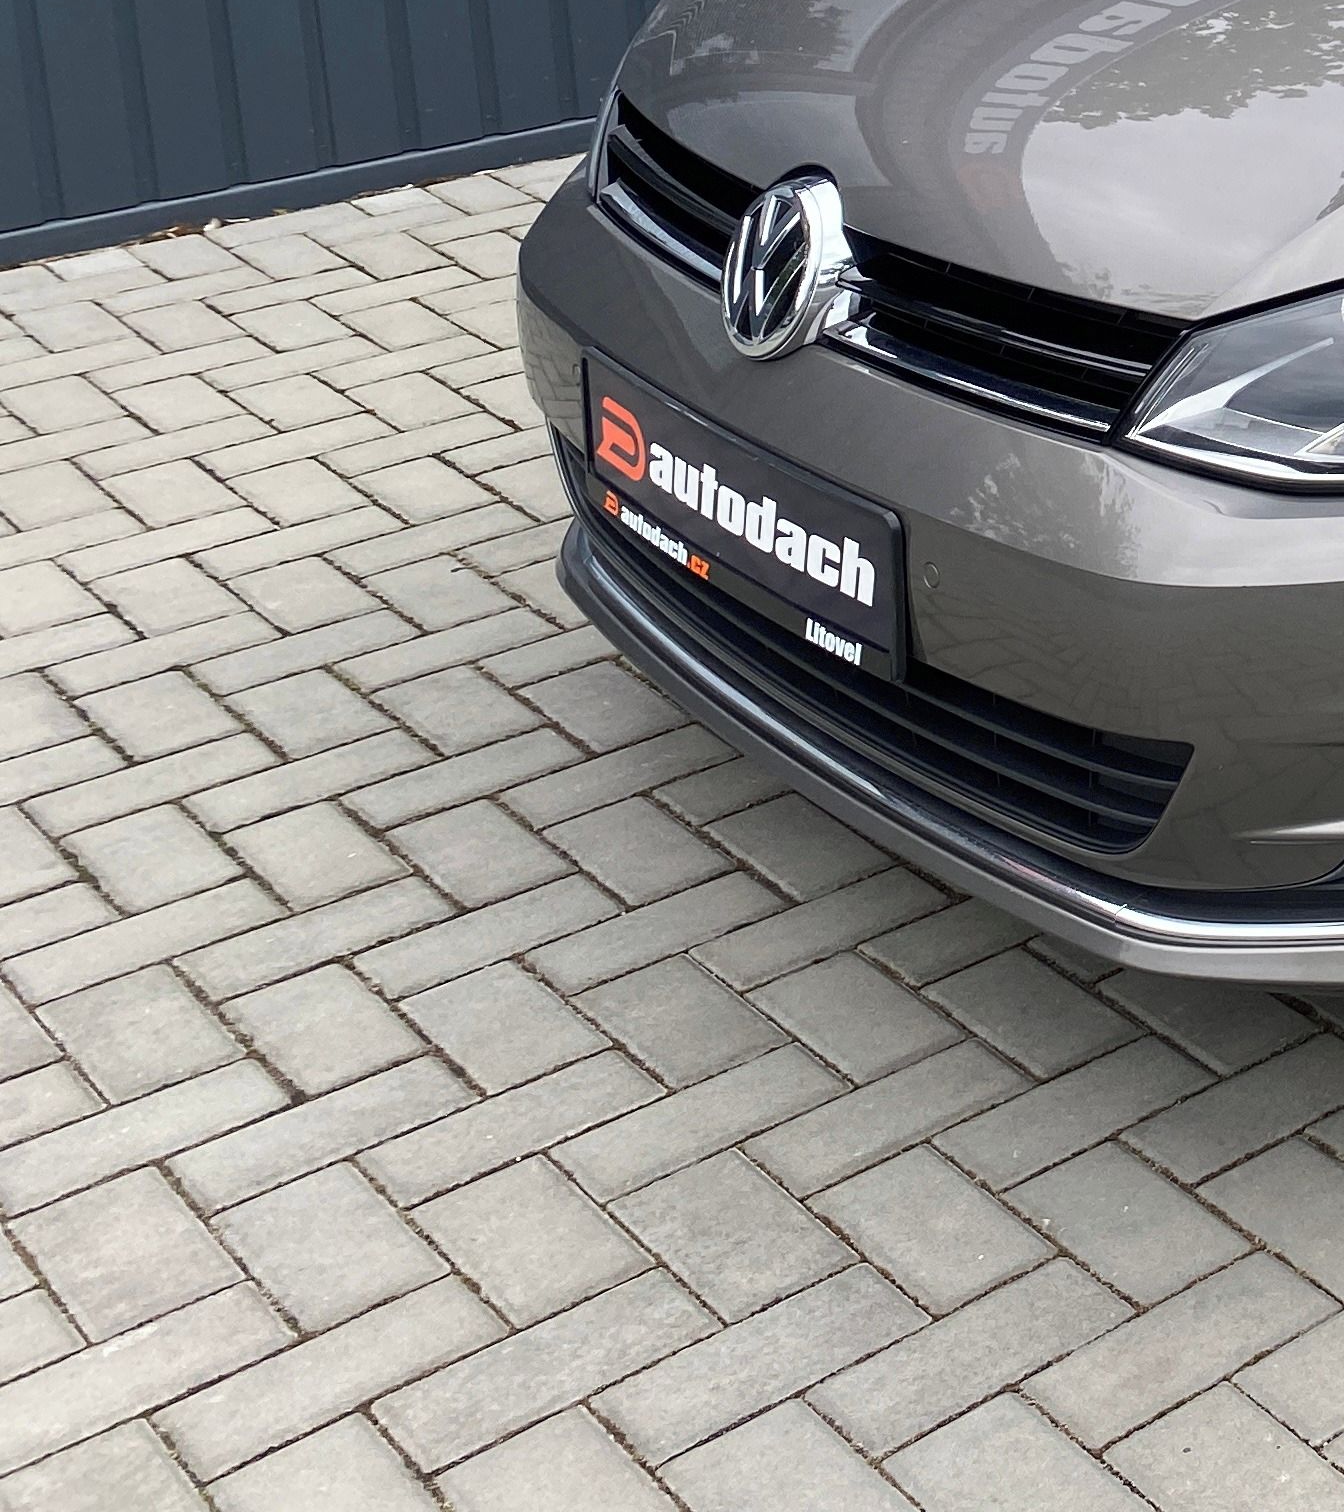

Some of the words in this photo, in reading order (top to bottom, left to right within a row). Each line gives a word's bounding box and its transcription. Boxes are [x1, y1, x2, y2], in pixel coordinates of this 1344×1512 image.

[620, 505, 710, 581] autodach.cz
[648, 441, 876, 608] autodach
[804, 617, 863, 667] Litovel
